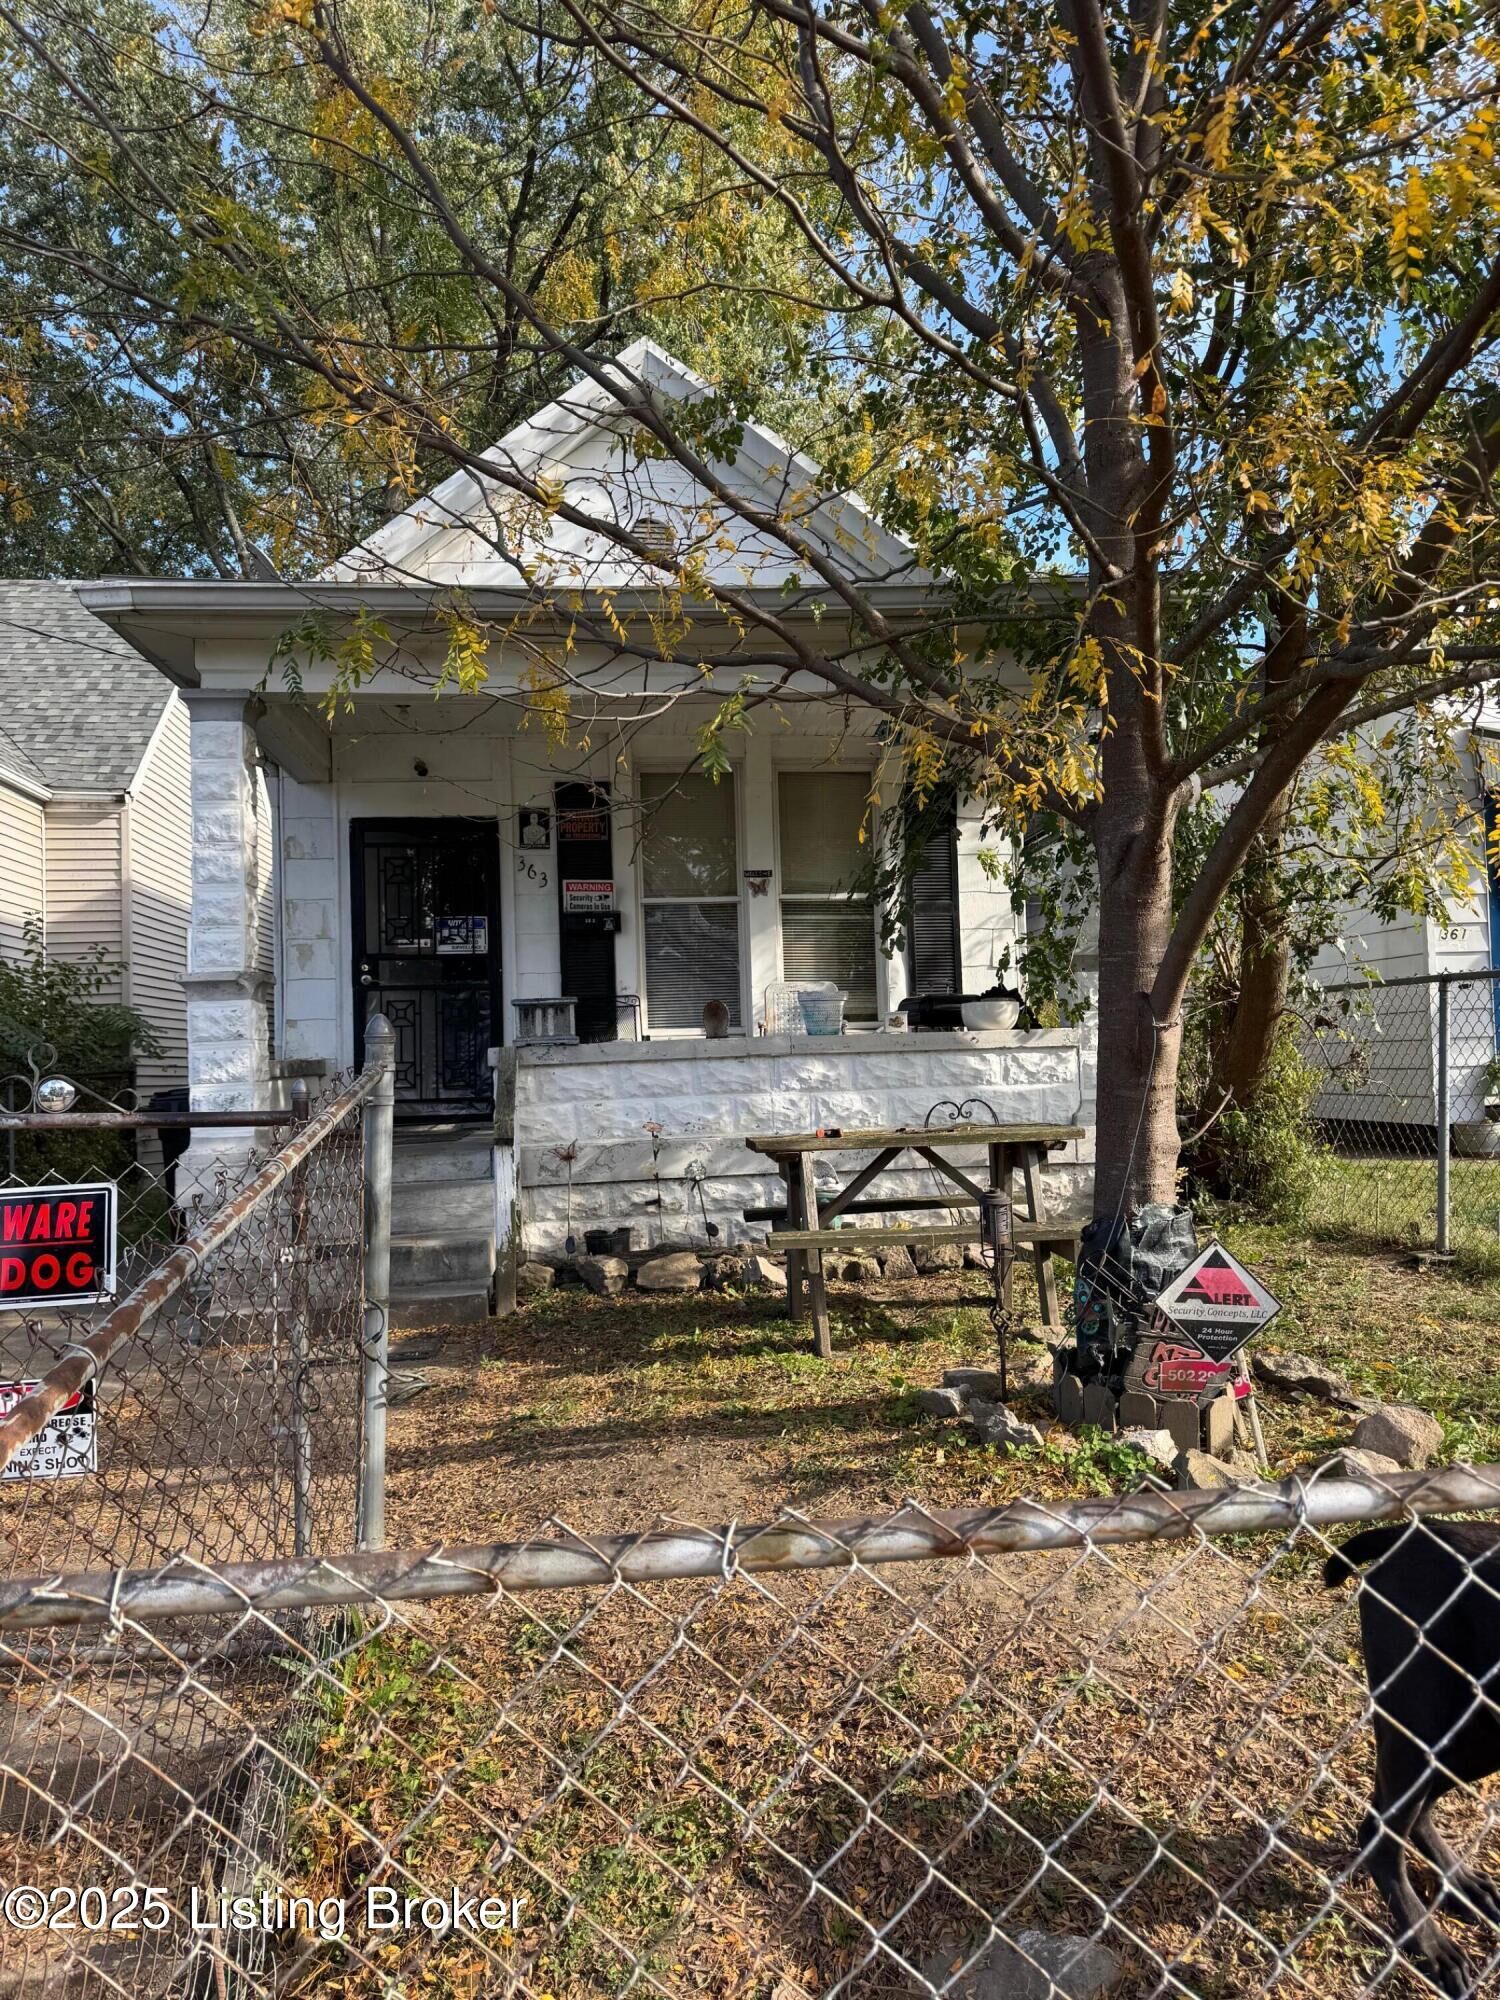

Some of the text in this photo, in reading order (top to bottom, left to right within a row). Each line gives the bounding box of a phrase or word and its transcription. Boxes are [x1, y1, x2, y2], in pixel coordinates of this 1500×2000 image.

[560, 822, 605, 832] PROPERTY
[517, 856, 548, 888] 363
[568, 883, 612, 891] WARNING
[569, 894, 593, 902] Security
[1441, 928, 1466, 940] 361
[1, 1252, 94, 1291] DOG
[1174, 1276, 1252, 1306] ALERT
[1168, 1305, 1269, 1320] Security Concepts, LLC
[20, 1446, 57, 1456] EXPECT
